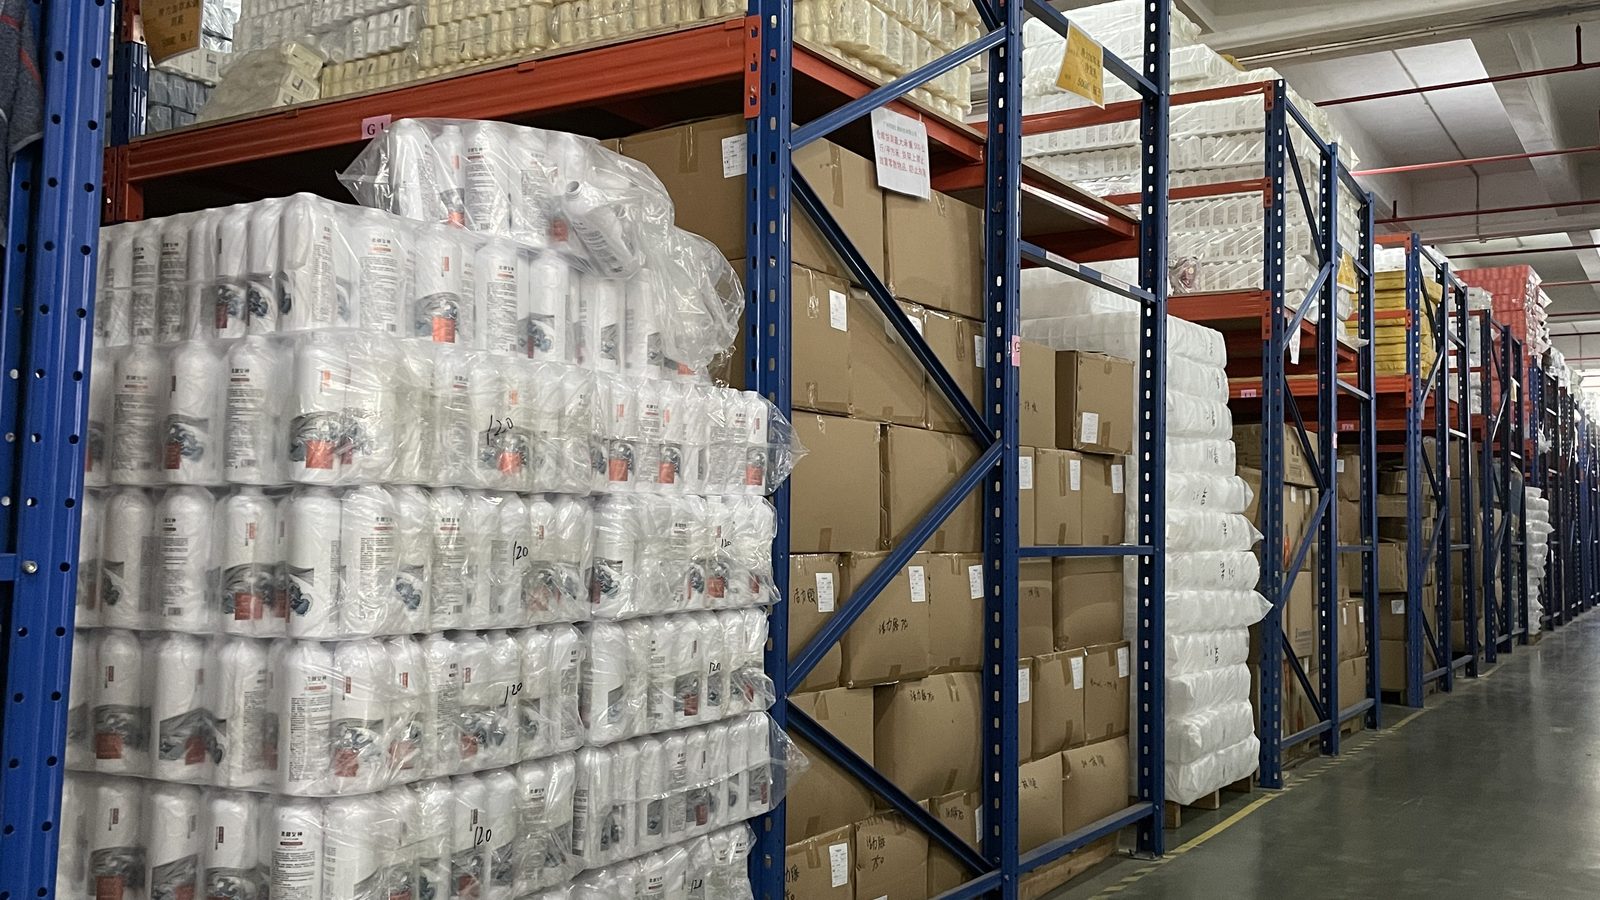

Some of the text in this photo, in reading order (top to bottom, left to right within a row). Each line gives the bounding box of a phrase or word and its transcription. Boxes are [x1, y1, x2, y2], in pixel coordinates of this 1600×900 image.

[487, 414, 514, 445] 120
[512, 540, 529, 566] 120
[503, 682, 523, 705] 120
[473, 826, 492, 849] 120
